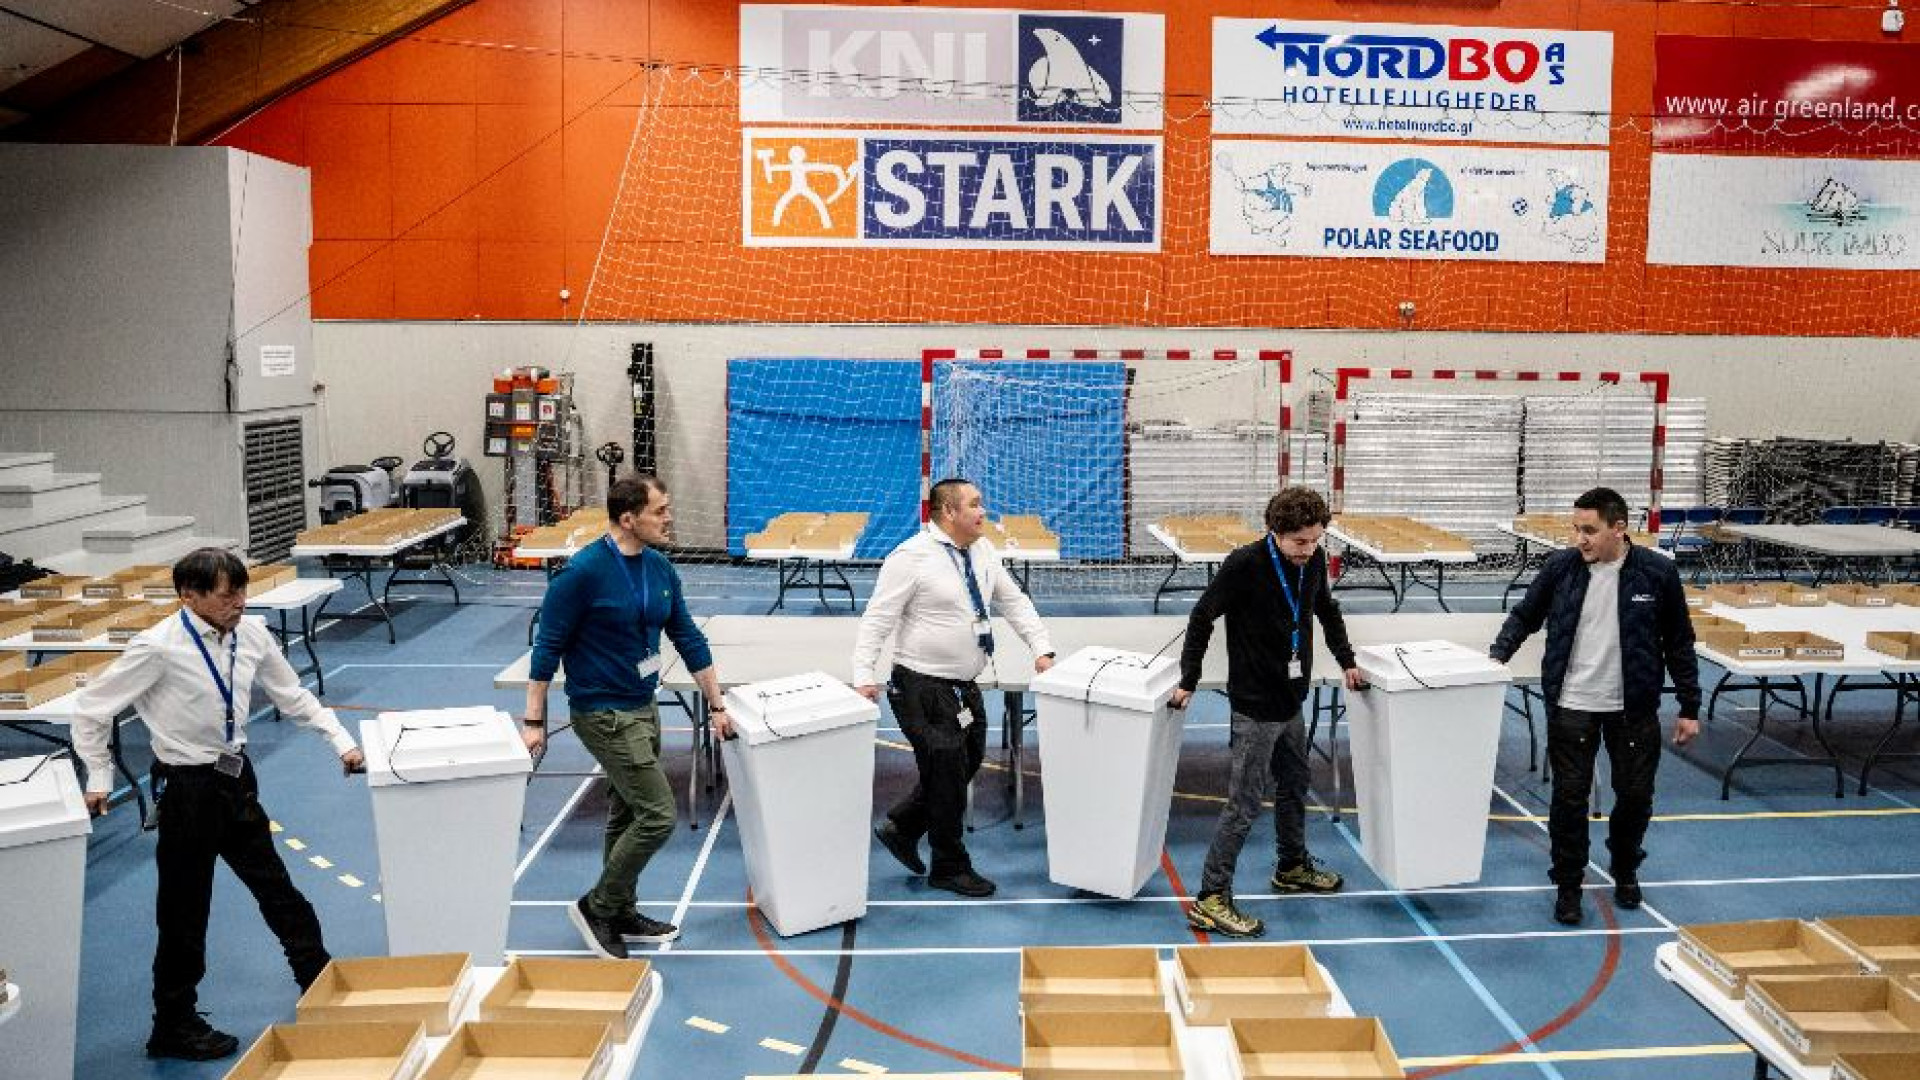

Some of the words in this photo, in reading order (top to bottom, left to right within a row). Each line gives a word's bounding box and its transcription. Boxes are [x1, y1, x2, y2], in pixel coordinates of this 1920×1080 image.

[808, 30, 987, 98] KNI
[1284, 38, 1540, 84] NORDBO
[1283, 86, 1537, 111] HOTELLEJLIGHEDER
[874, 149, 1145, 232] STARK
[1324, 228, 1392, 250] POLAR
[1399, 229, 1499, 252] SEAFOOD
